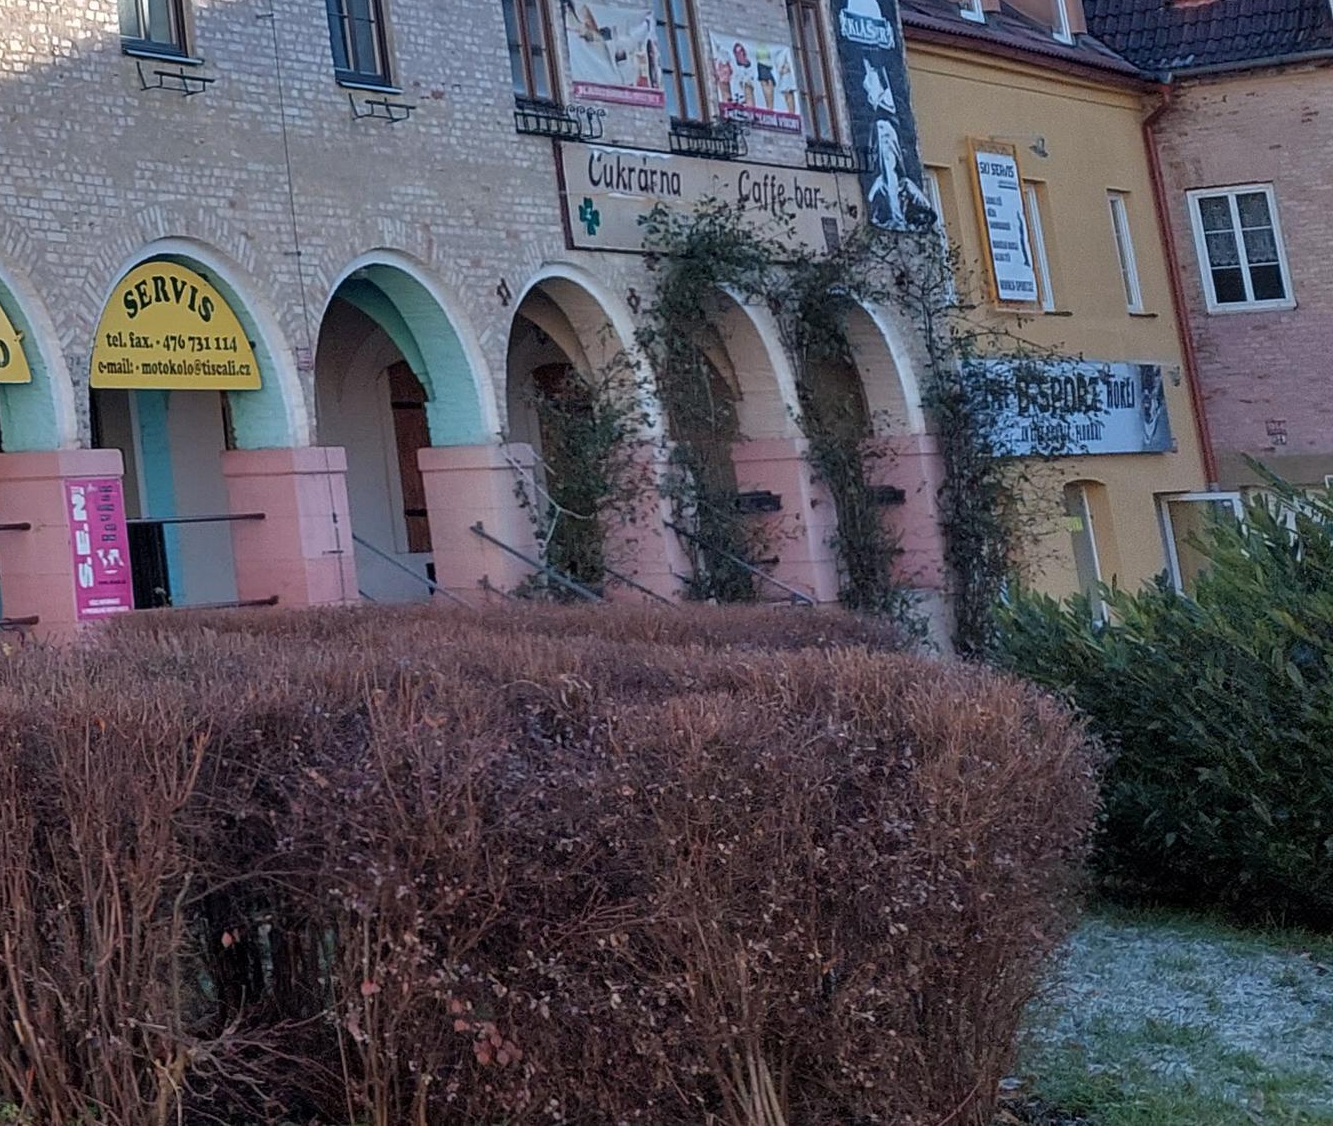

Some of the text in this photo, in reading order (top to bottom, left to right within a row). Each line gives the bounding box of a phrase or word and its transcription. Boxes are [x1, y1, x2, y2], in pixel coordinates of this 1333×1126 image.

[123, 275, 215, 323] SERVIS
[106, 332, 127, 348] tel.
[129, 332, 154, 349] fax.
[162, 334, 186, 352] 476
